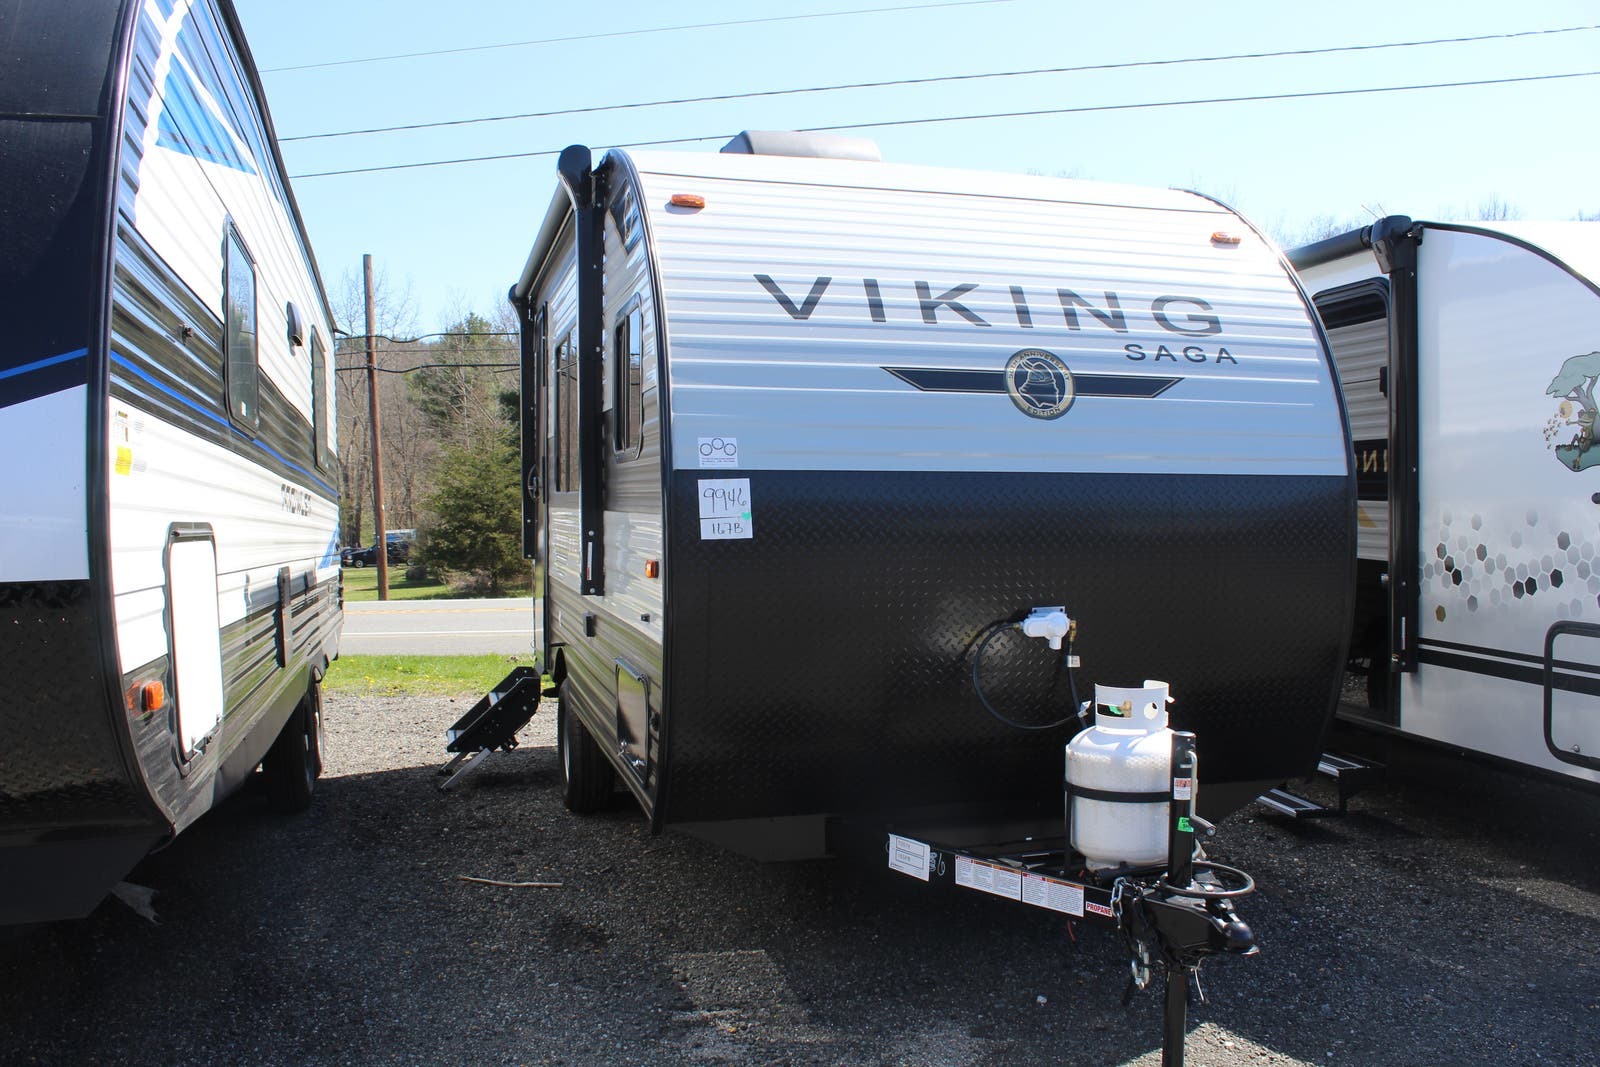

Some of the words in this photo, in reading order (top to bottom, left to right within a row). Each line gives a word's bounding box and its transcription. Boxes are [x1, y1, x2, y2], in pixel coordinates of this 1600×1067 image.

[753, 274, 1223, 338] VIKING
[1123, 343, 1239, 365] SAGA
[703, 487, 747, 514] 9946
[712, 522, 744, 536] 167B
[1086, 902, 1112, 916] PROPANE
